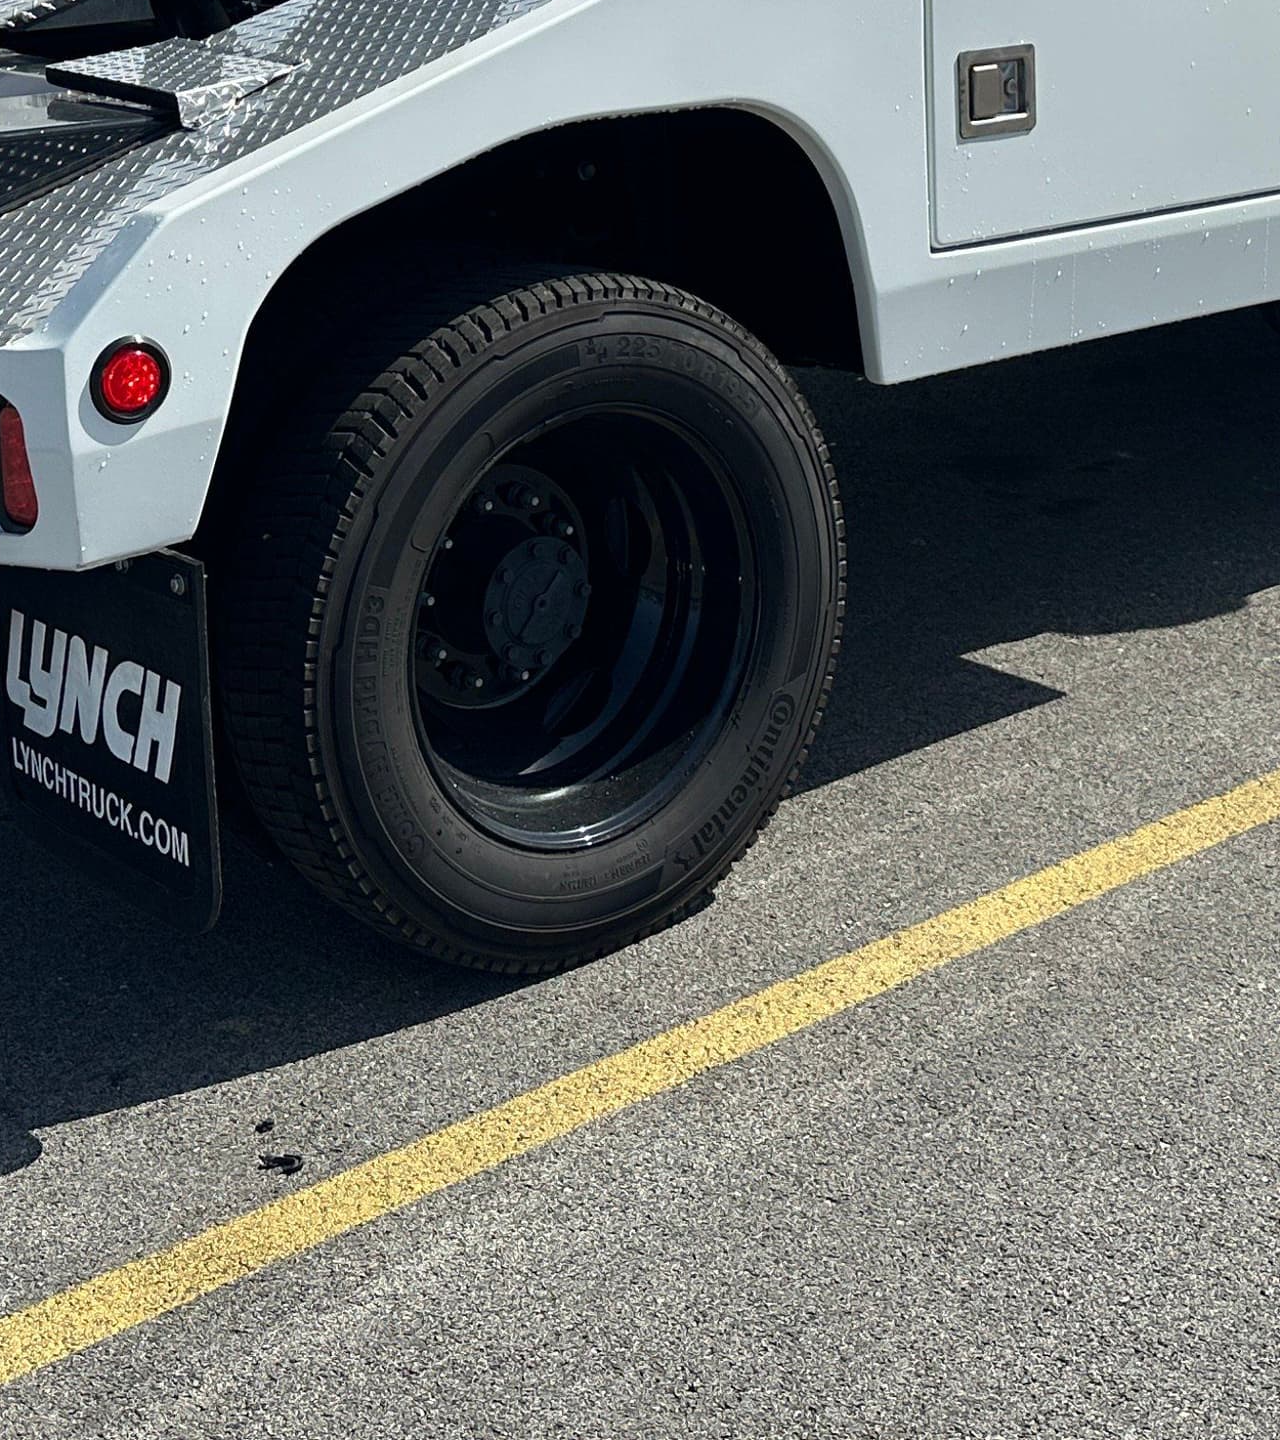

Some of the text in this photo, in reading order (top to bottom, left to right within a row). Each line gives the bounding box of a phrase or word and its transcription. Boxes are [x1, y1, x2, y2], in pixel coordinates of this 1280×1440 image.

[6, 608, 182, 784] LYNCH
[692, 693, 796, 857] Continental
[12, 736, 190, 868] LYNCHTRUCK.COM
